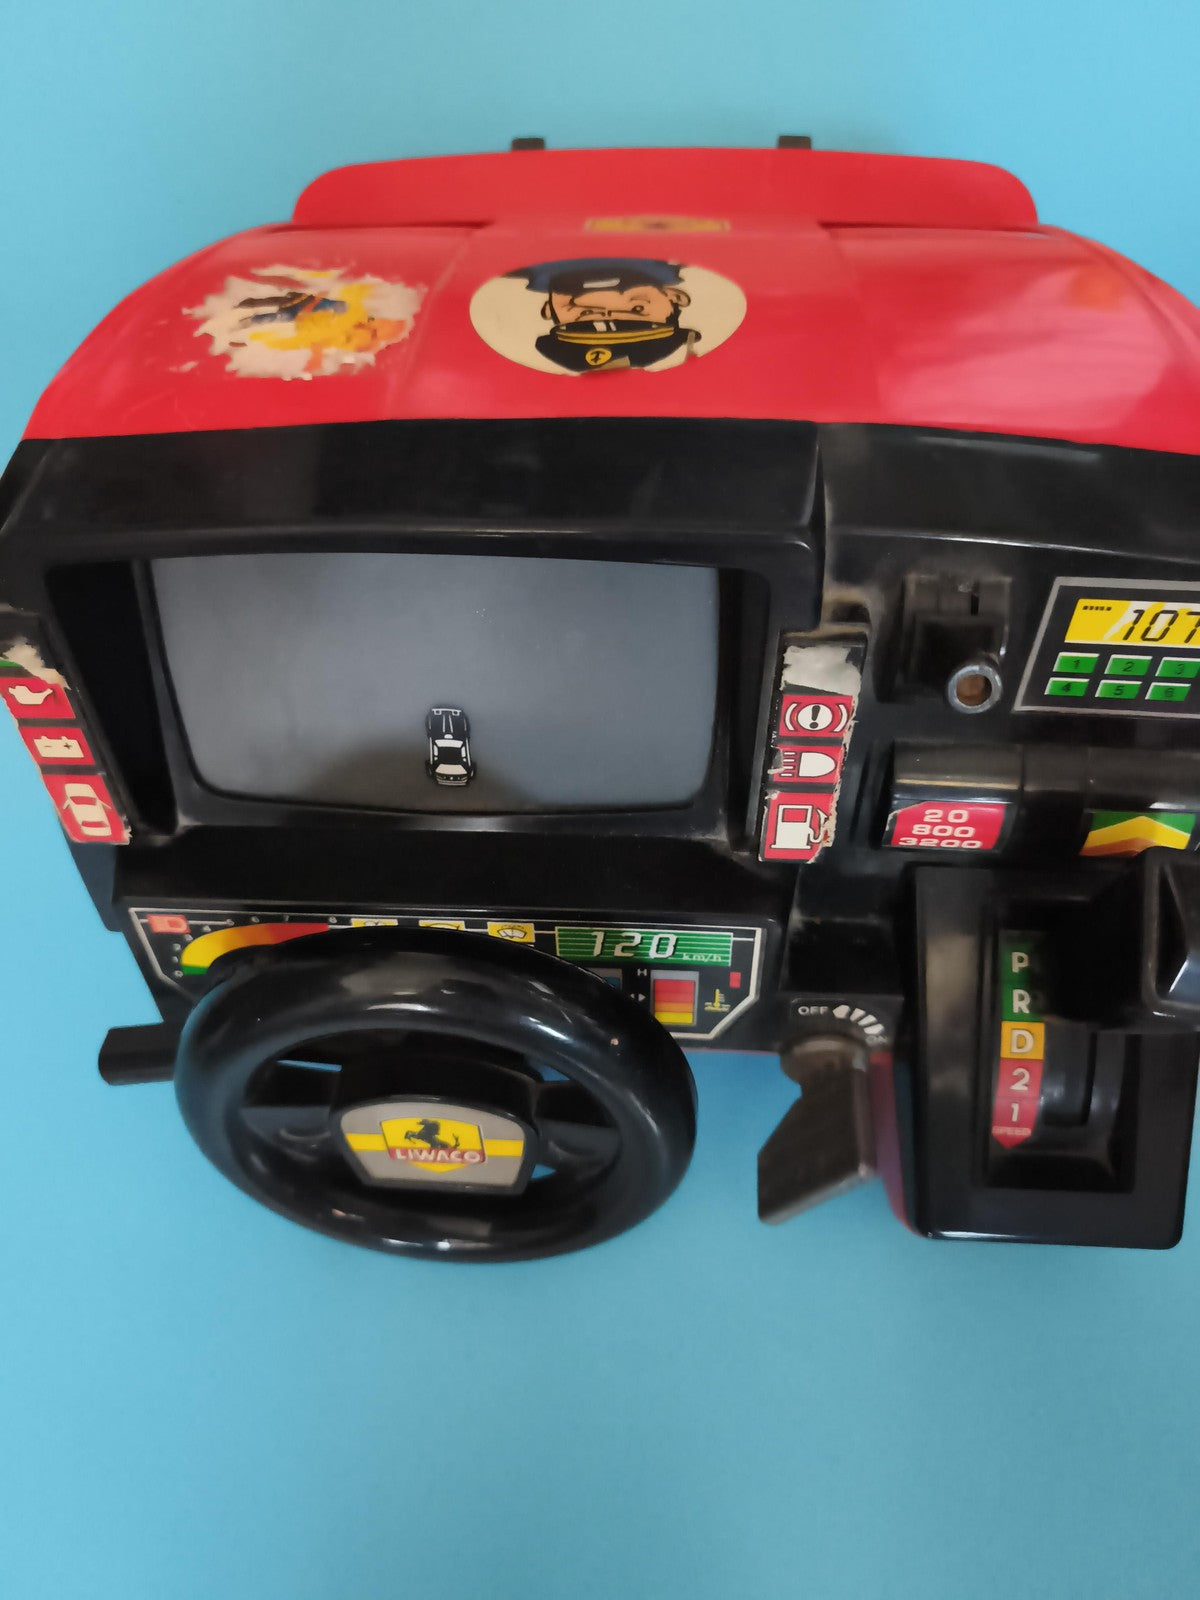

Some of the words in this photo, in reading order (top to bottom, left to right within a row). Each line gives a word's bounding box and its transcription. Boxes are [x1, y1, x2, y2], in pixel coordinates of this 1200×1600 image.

[1072, 659, 1081, 670] 1
[1122, 661, 1136, 673] 2
[1173, 663, 1186, 676] 3
[1061, 682, 1073, 693] 4
[1113, 685, 1126, 696] 5
[1163, 687, 1175, 698] 6
[923, 809, 969, 823] 20
[911, 824, 976, 838] 800
[898, 837, 984, 849] 3200
[591, 931, 678, 959] 120
[1011, 951, 1029, 974] P
[1012, 988, 1032, 1014] R
[797, 1005, 829, 1016] OFF
[1009, 1029, 1035, 1054] D
[1010, 1067, 1031, 1093] 2
[1010, 1102, 1020, 1122] 1
[395, 1148, 482, 1163] LIWACO
